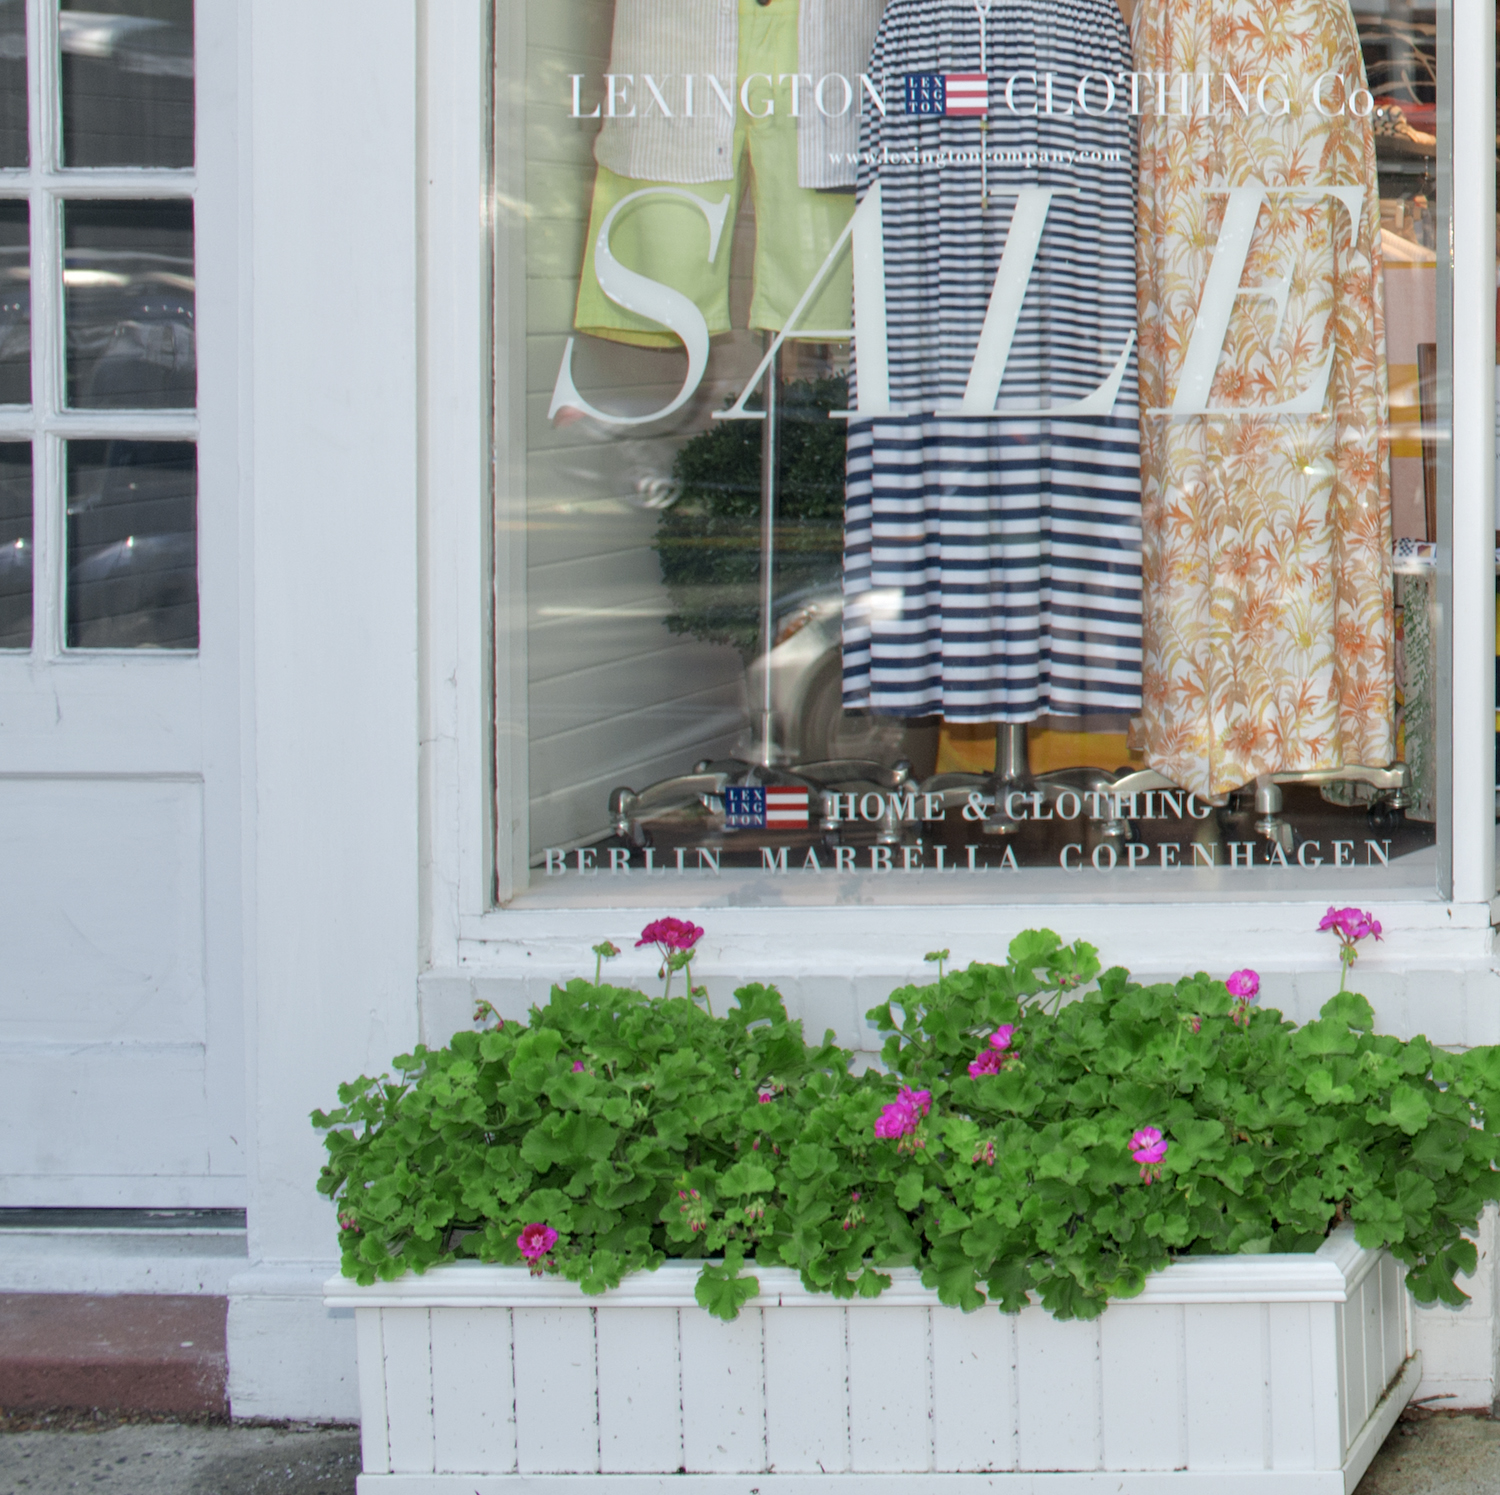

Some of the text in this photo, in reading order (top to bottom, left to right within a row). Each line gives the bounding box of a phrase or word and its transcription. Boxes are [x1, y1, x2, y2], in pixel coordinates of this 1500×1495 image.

[567, 72, 886, 118] LEXINGTON
[909, 77, 943, 88] LEX
[910, 90, 943, 101] ING
[1005, 71, 1384, 117] CLOTHING Co.
[909, 102, 943, 113] TON
[829, 147, 1122, 169] www.lexingtoncompany.com
[547, 185, 1366, 426] SALE
[730, 790, 762, 801] LEX
[730, 802, 763, 813] ING
[831, 790, 1213, 821] HOME & CLOTHING
[729, 814, 763, 826] TON
[543, 846, 722, 877] BERLIN
[759, 844, 1020, 875] MARBELLA
[1059, 839, 1392, 873] COPENHAGEN
